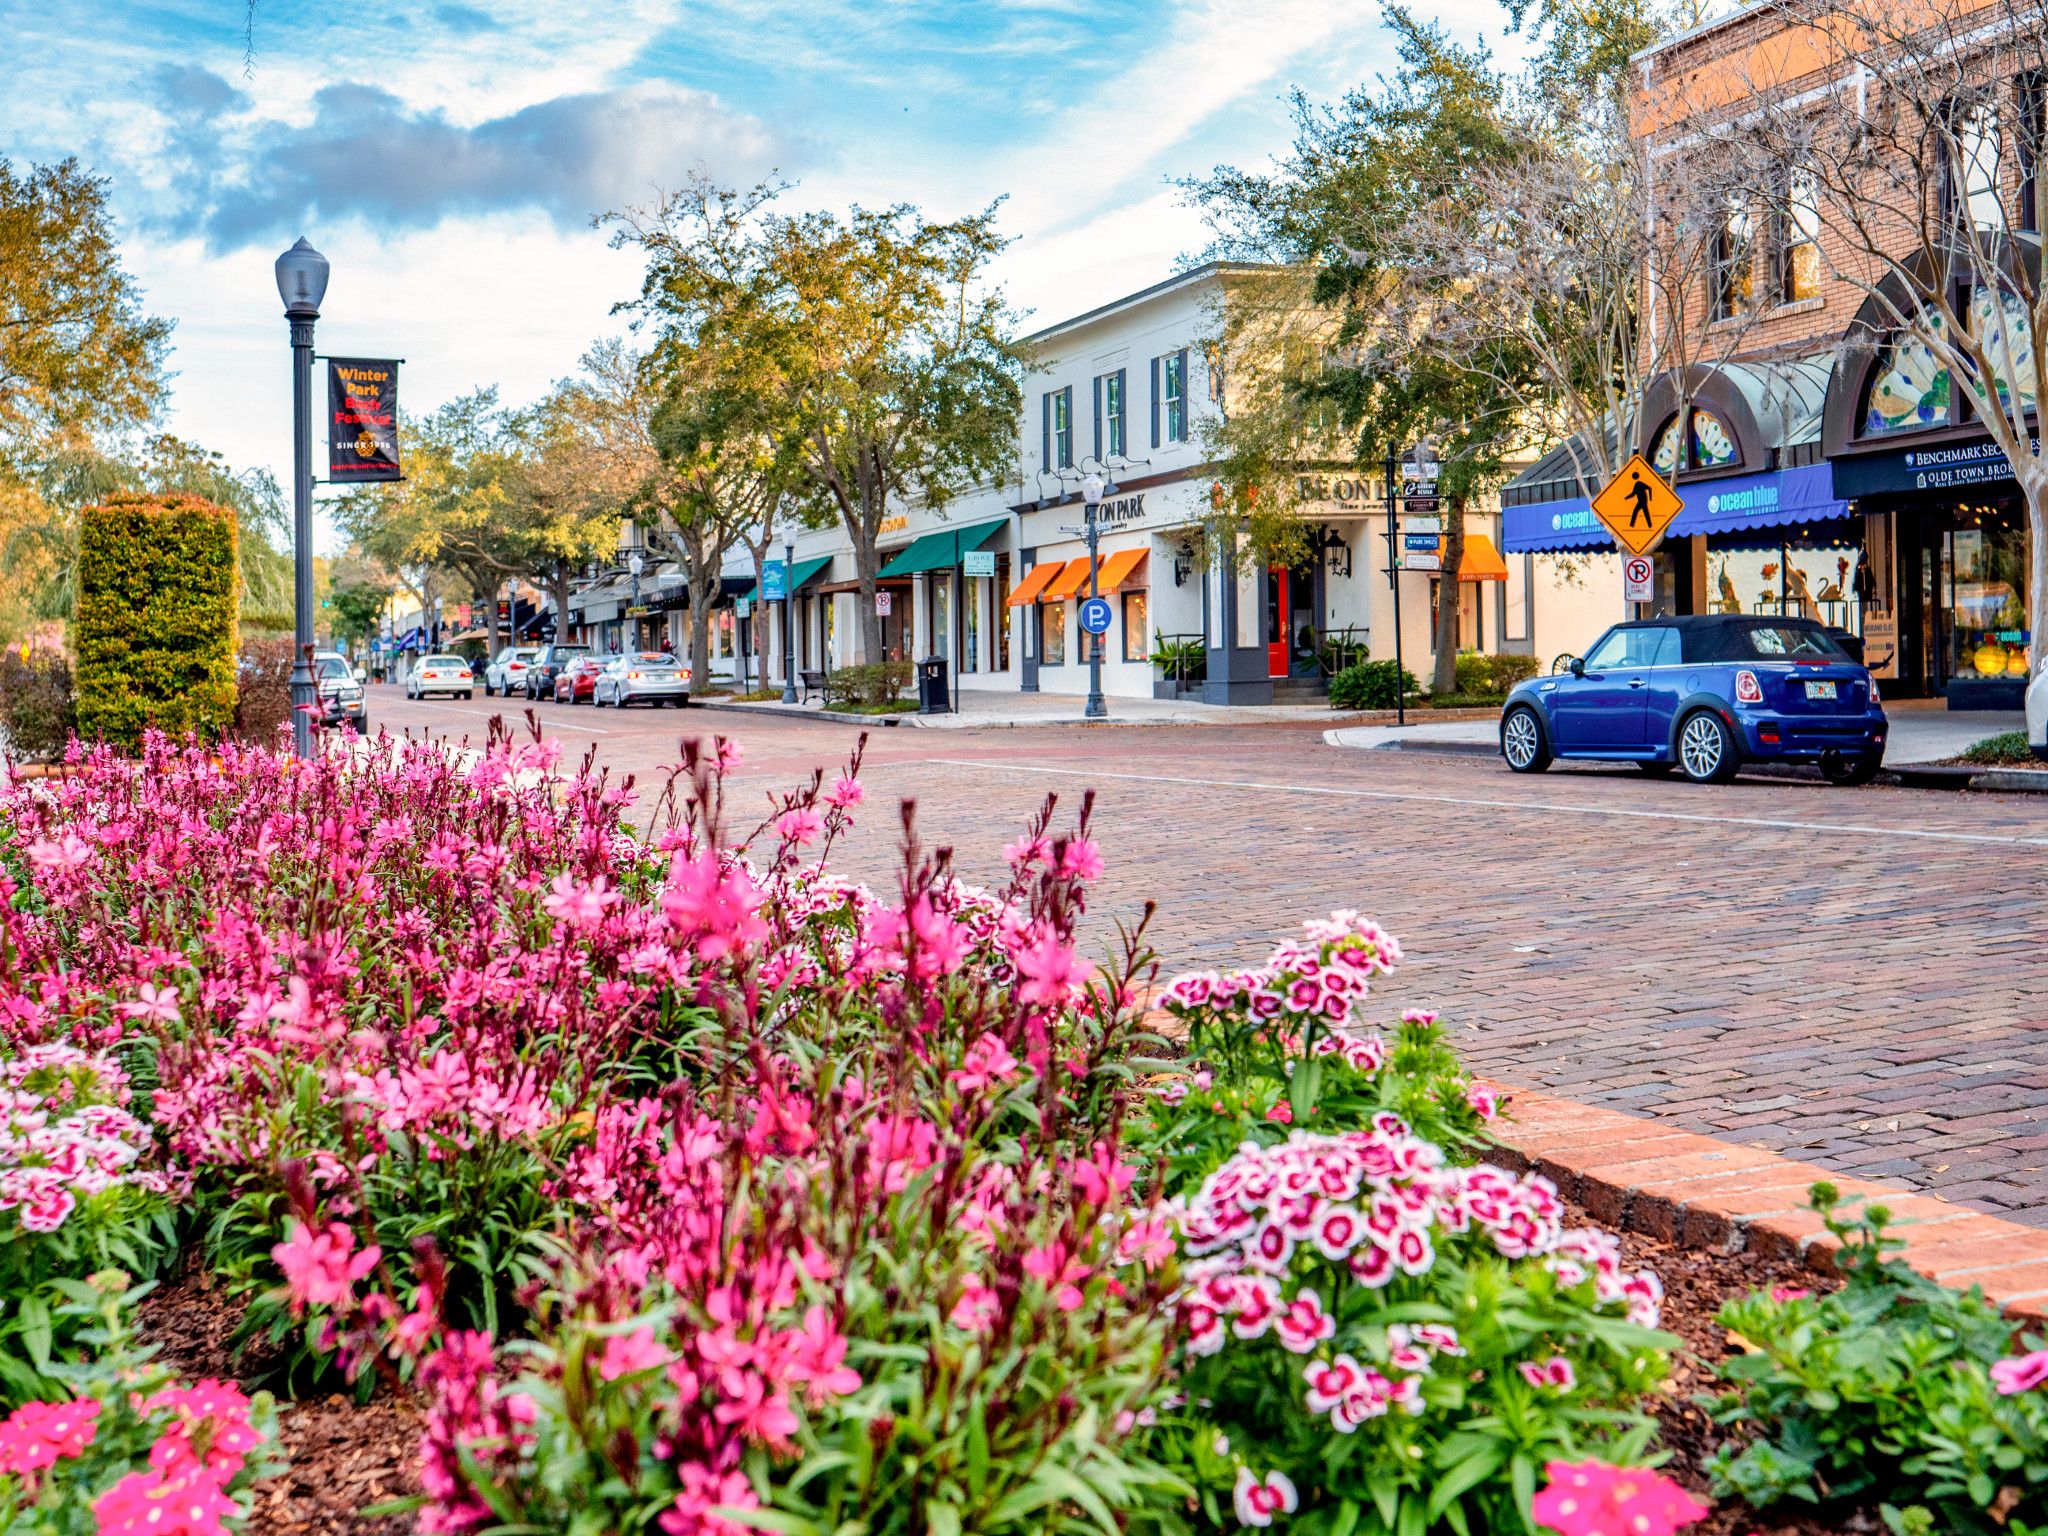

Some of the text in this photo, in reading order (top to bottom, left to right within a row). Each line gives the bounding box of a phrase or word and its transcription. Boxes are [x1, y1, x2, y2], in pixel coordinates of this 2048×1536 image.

[338, 367, 388, 382] Winter
[346, 382, 379, 396] Park
[345, 397, 381, 411] Bach
[335, 412, 391, 426] Festival
[336, 441, 367, 450] SINCE
[1916, 446, 1982, 466] BENCHMARK
[1928, 462, 2014, 483] OLDE TOWN BROK
[1099, 502, 1116, 523] ON
[1117, 494, 1146, 521] PARK
[1745, 505, 1779, 516] GALLERIES
[1088, 605, 1105, 627] P
